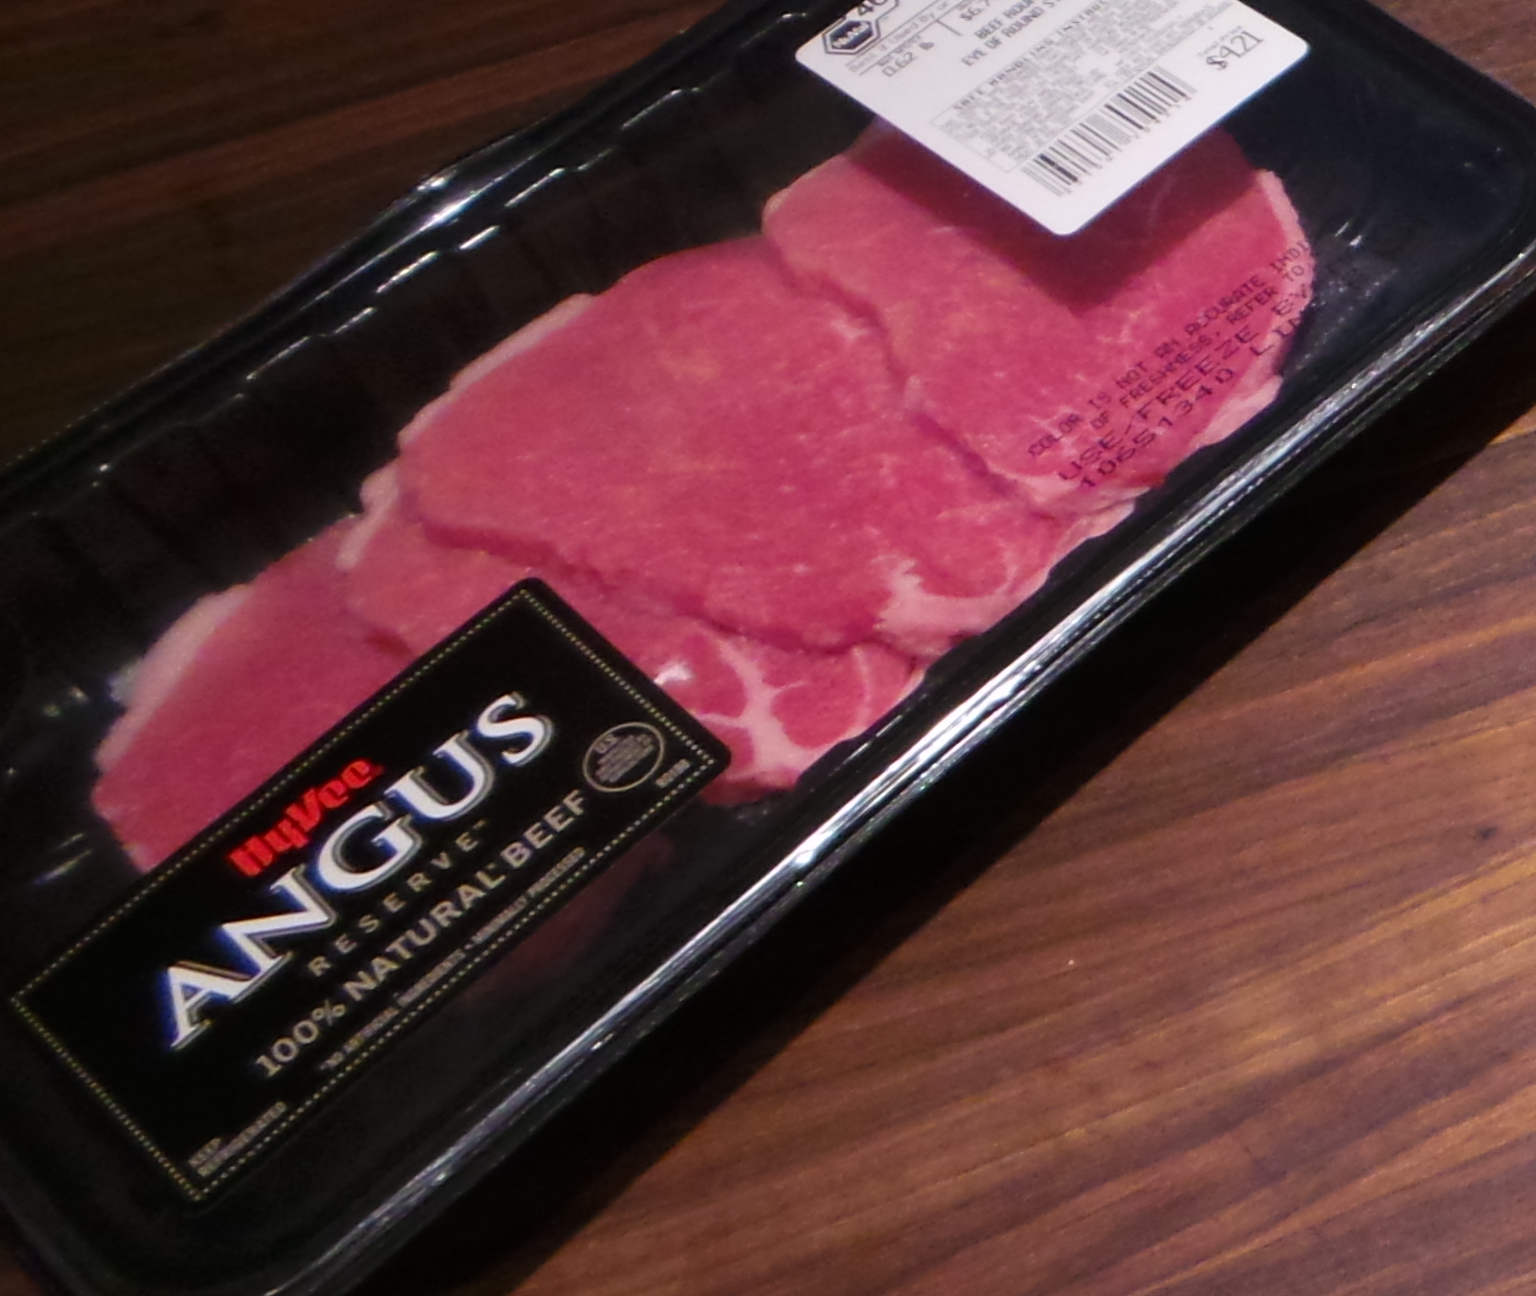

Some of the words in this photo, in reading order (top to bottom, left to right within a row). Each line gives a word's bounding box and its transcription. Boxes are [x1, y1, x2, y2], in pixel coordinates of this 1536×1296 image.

[887, 21, 920, 45] Used
[916, 10, 937, 24] By
[960, 48, 988, 67] EYE
[983, 35, 1005, 50] OF
[1000, 5, 1046, 38] ROUND
[973, 16, 1006, 39] BEEF
[986, 37, 1056, 87] HANDLING
[1025, 410, 1085, 459] COLOR
[1114, 361, 1150, 390] NOT
[1183, 271, 1265, 340] ACCURATE
[1088, 409, 1115, 430] OF
[1225, 283, 1278, 327] REFER
[1280, 261, 1307, 285] TO
[157, 691, 559, 1050] ANGUS
[227, 758, 386, 878] HyVee
[252, 994, 350, 1078] 100%
[496, 788, 594, 870] BEEF
[307, 833, 482, 978] RESERVE
